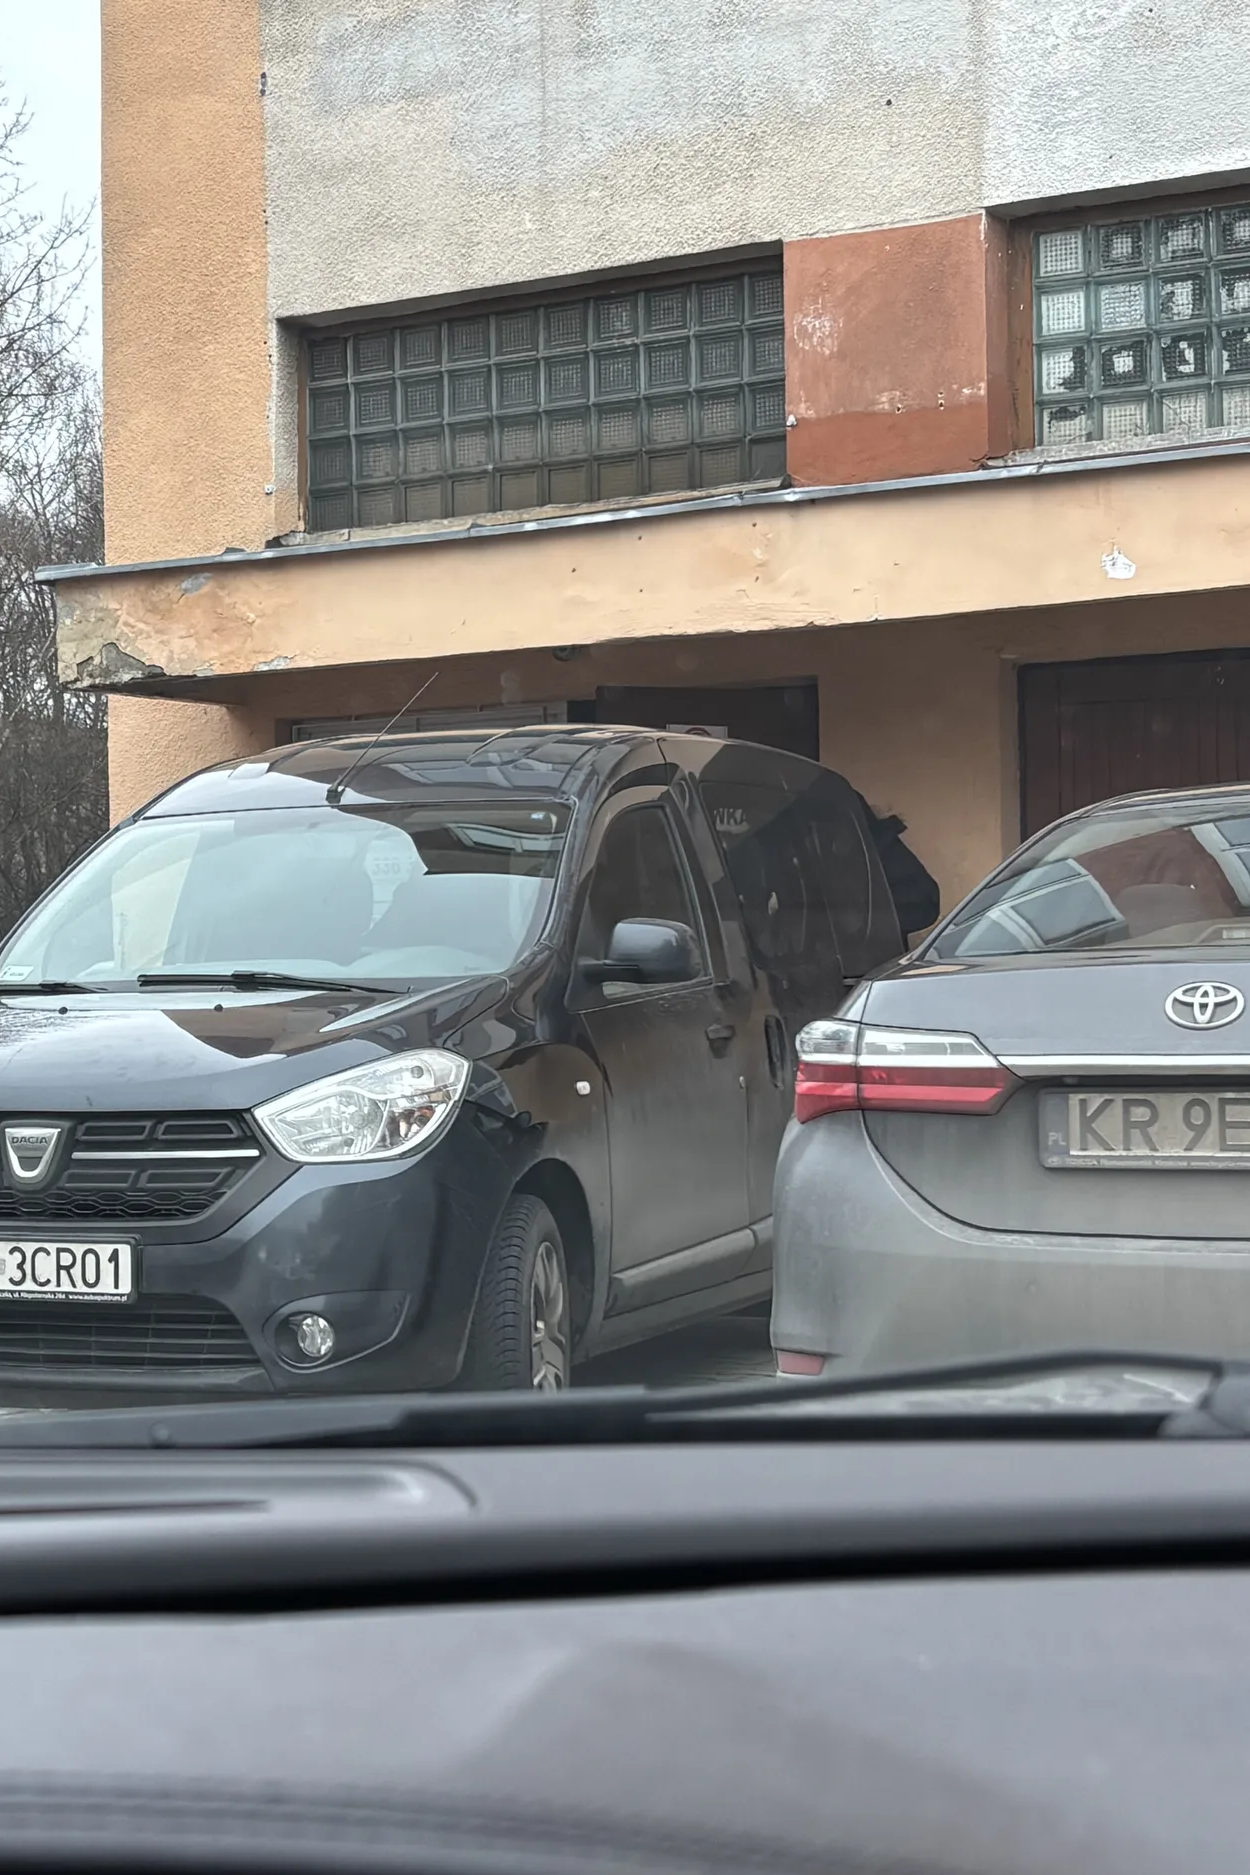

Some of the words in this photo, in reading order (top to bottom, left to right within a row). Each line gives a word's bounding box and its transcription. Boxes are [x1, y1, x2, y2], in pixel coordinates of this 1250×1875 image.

[1047, 1132, 1067, 1145] PL
[1078, 1097, 1160, 1151] KR
[1182, 1097, 1250, 1151] 9E
[11, 1136, 48, 1144] DACIA
[8, 1245, 120, 1290] 3CR01
